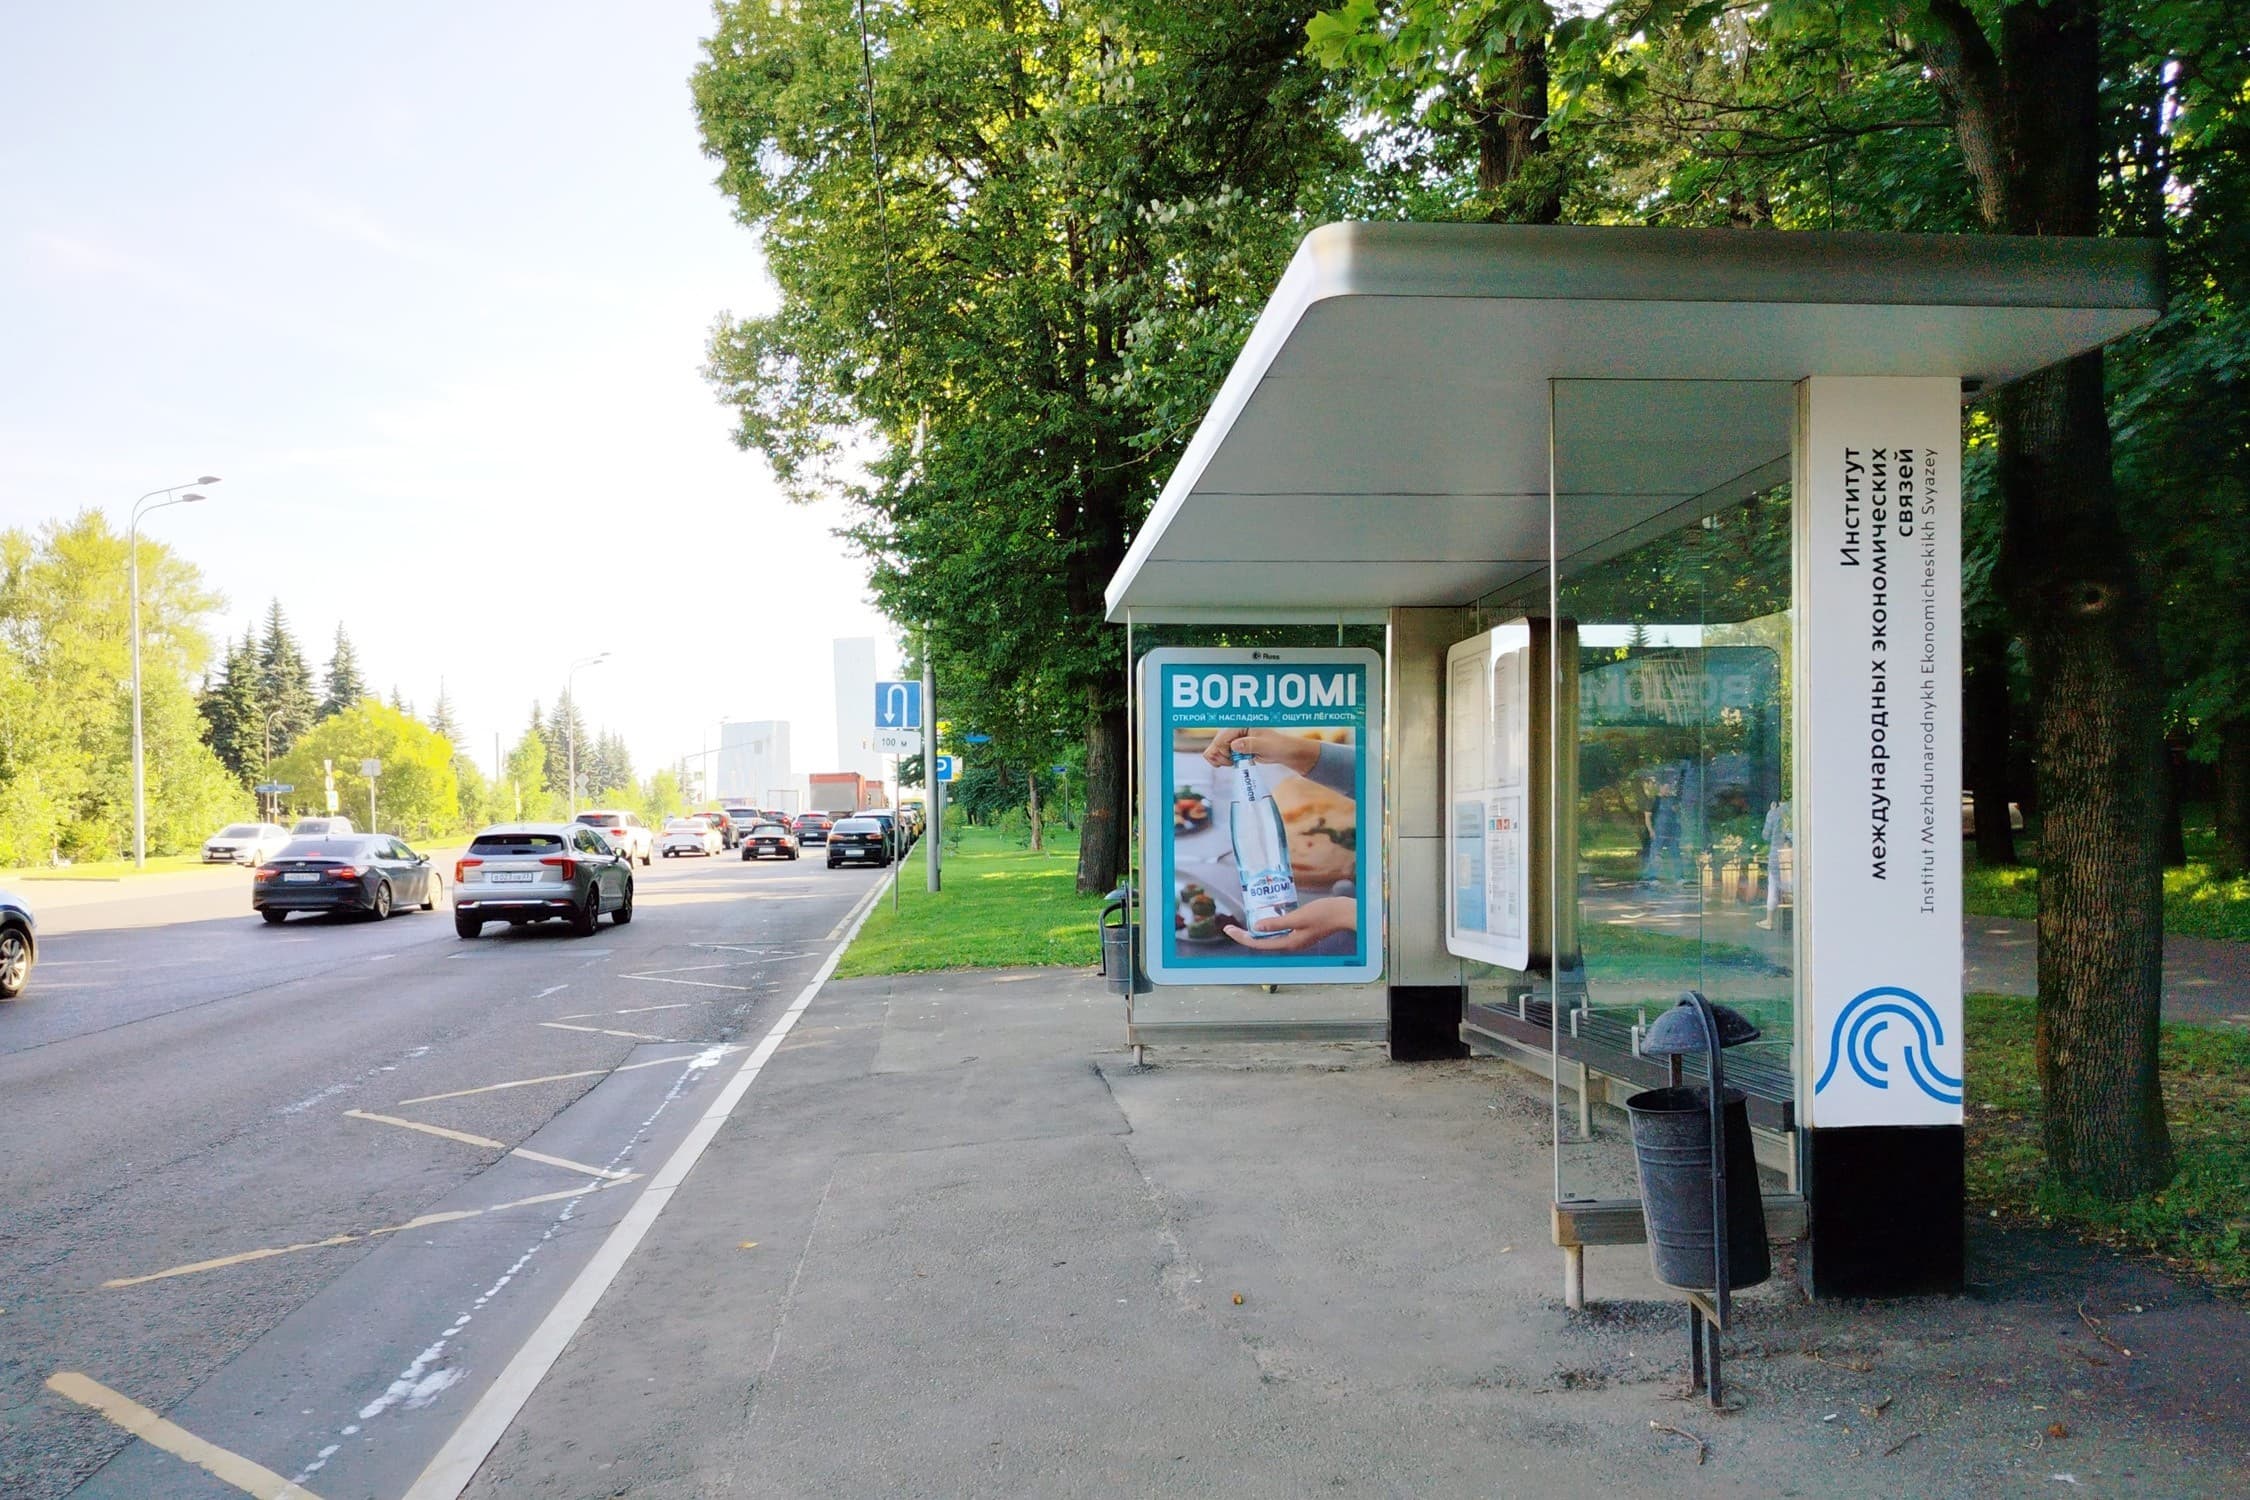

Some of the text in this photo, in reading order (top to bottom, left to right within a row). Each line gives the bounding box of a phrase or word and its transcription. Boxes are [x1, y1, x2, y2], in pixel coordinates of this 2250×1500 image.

[1840, 447, 1864, 566] Институт
[1894, 448, 1913, 537] связей
[1871, 448, 1890, 880] международных экономических
[1920, 448, 1938, 914] Institut Mezhdunarodnykh Ekonomicheskikh Svyazey
[1171, 672, 1357, 709] BORJOMI
[1172, 711, 1356, 722] ОТКРОЙ НАСЛАДИСЬ ОЩУТИ ЛЁГКОСТЬ
[881, 737, 896, 747] 100
[1243, 769, 1255, 802] BORJOMI
[1250, 882, 1290, 897] BORJOMI
